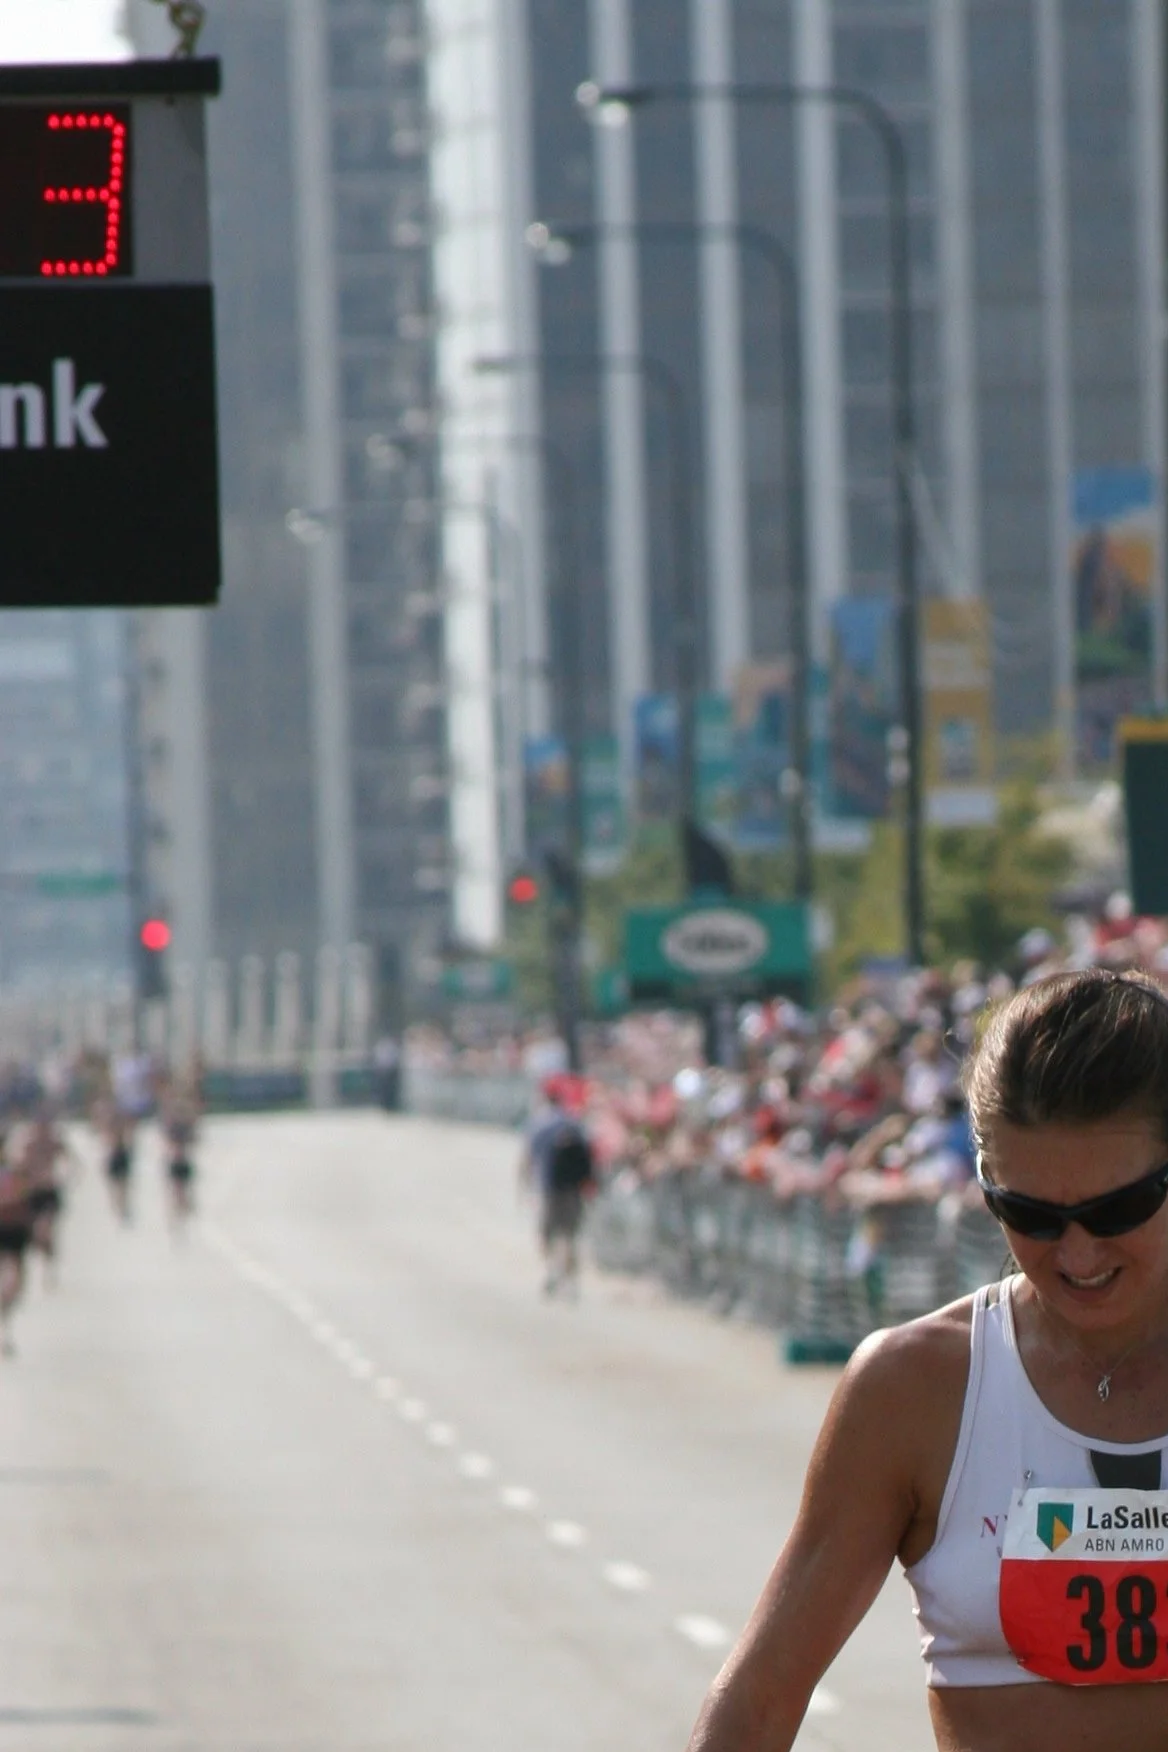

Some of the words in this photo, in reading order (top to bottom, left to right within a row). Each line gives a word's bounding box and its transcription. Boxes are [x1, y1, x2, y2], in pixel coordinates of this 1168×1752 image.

[40, 114, 126, 277] 3
[1083, 1537, 1116, 1553] ABN
[1120, 1536, 1166, 1553] AMRO
